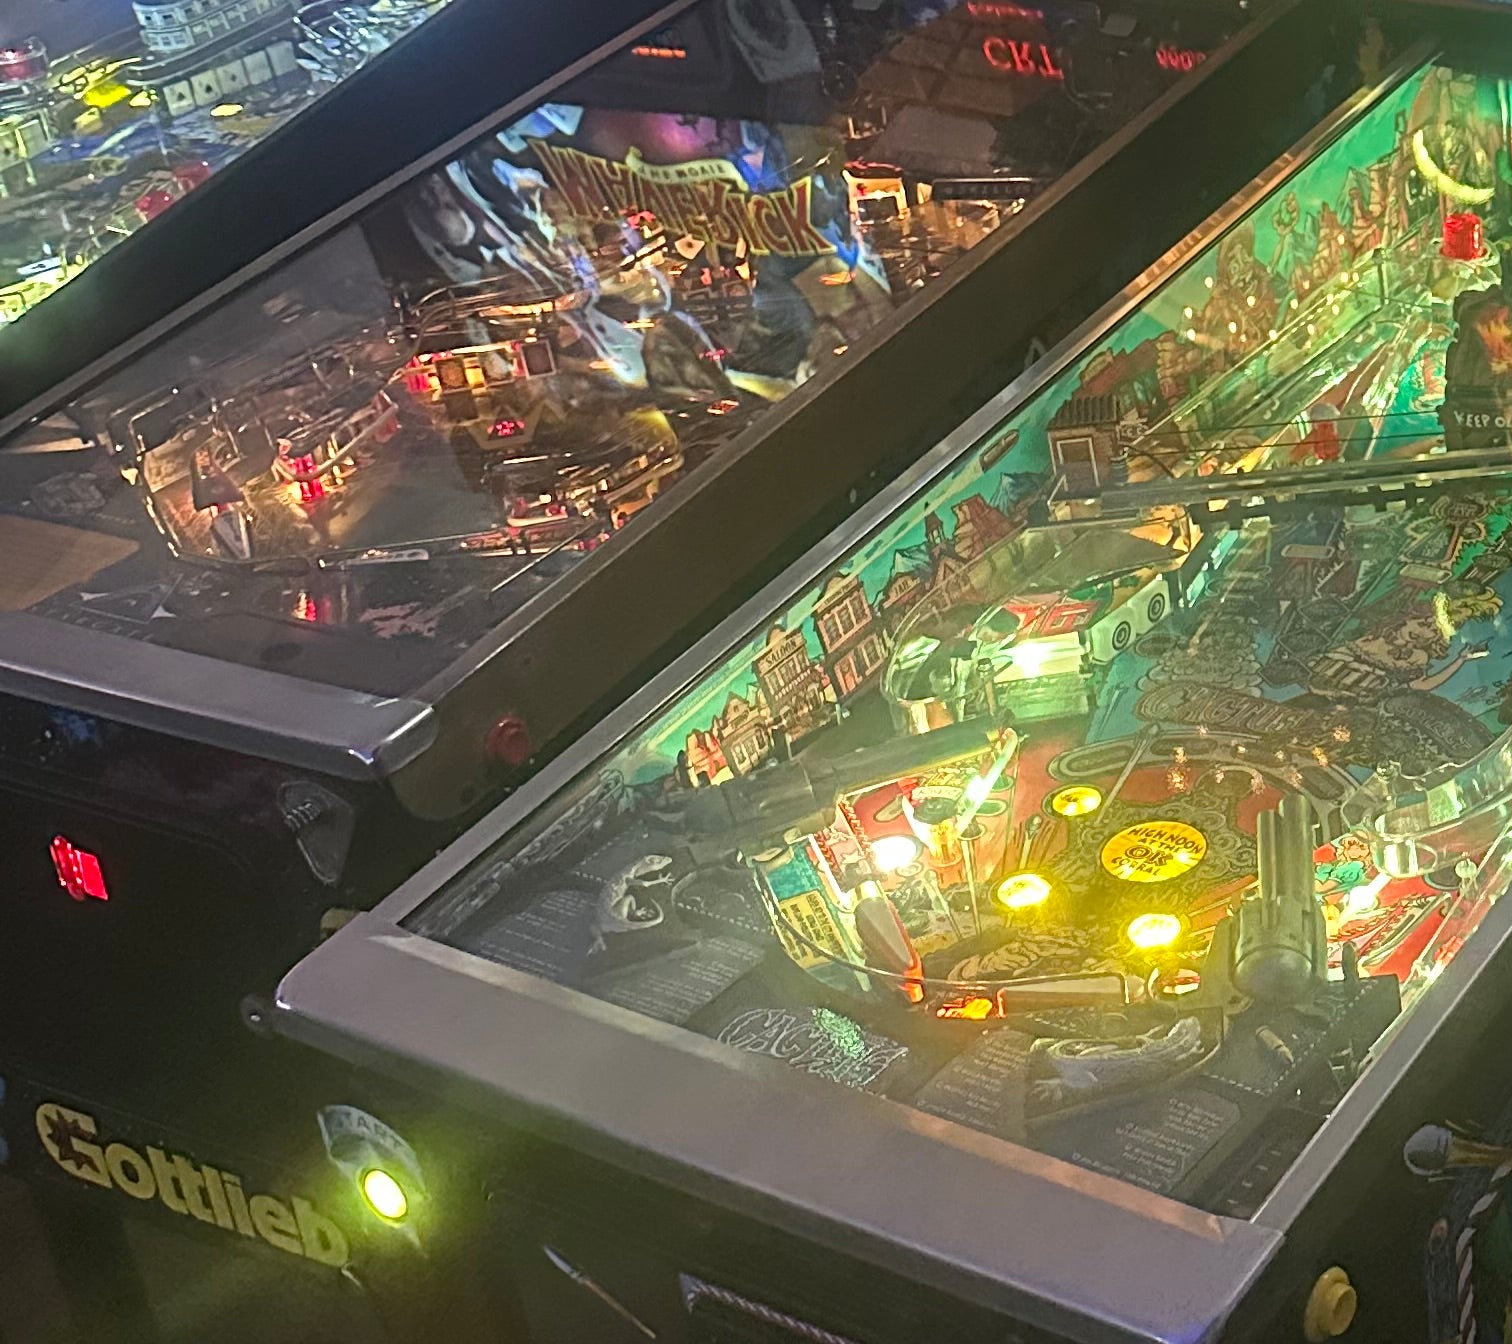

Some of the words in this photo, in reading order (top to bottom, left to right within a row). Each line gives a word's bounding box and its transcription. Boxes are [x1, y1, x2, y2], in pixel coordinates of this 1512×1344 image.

[764, 637, 798, 667] SALOON
[1128, 827, 1167, 840] HIGH
[1166, 832, 1204, 855] NOON
[1137, 837, 1157, 845] AT
[1111, 856, 1162, 876] CORRAL
[35, 1101, 350, 1268] Gottlieb
